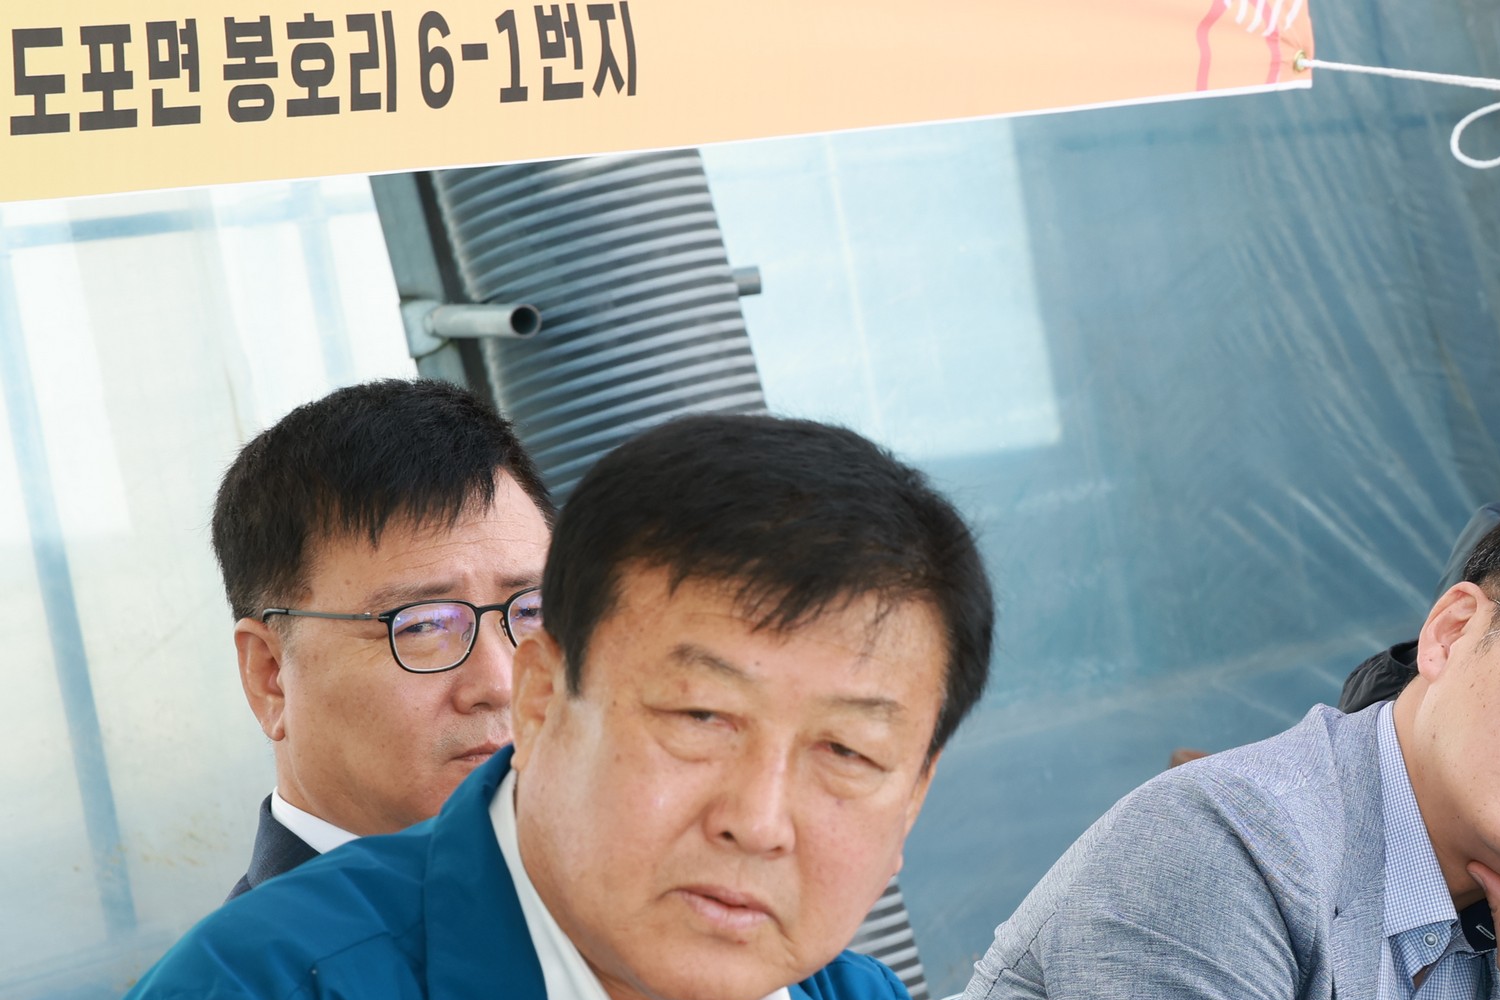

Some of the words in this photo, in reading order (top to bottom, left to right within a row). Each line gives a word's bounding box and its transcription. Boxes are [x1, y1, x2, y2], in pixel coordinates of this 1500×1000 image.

[10, 18, 201, 136] 도포면
[222, 10, 397, 123] 봉호리
[417, 0, 638, 110] 6-1번지
